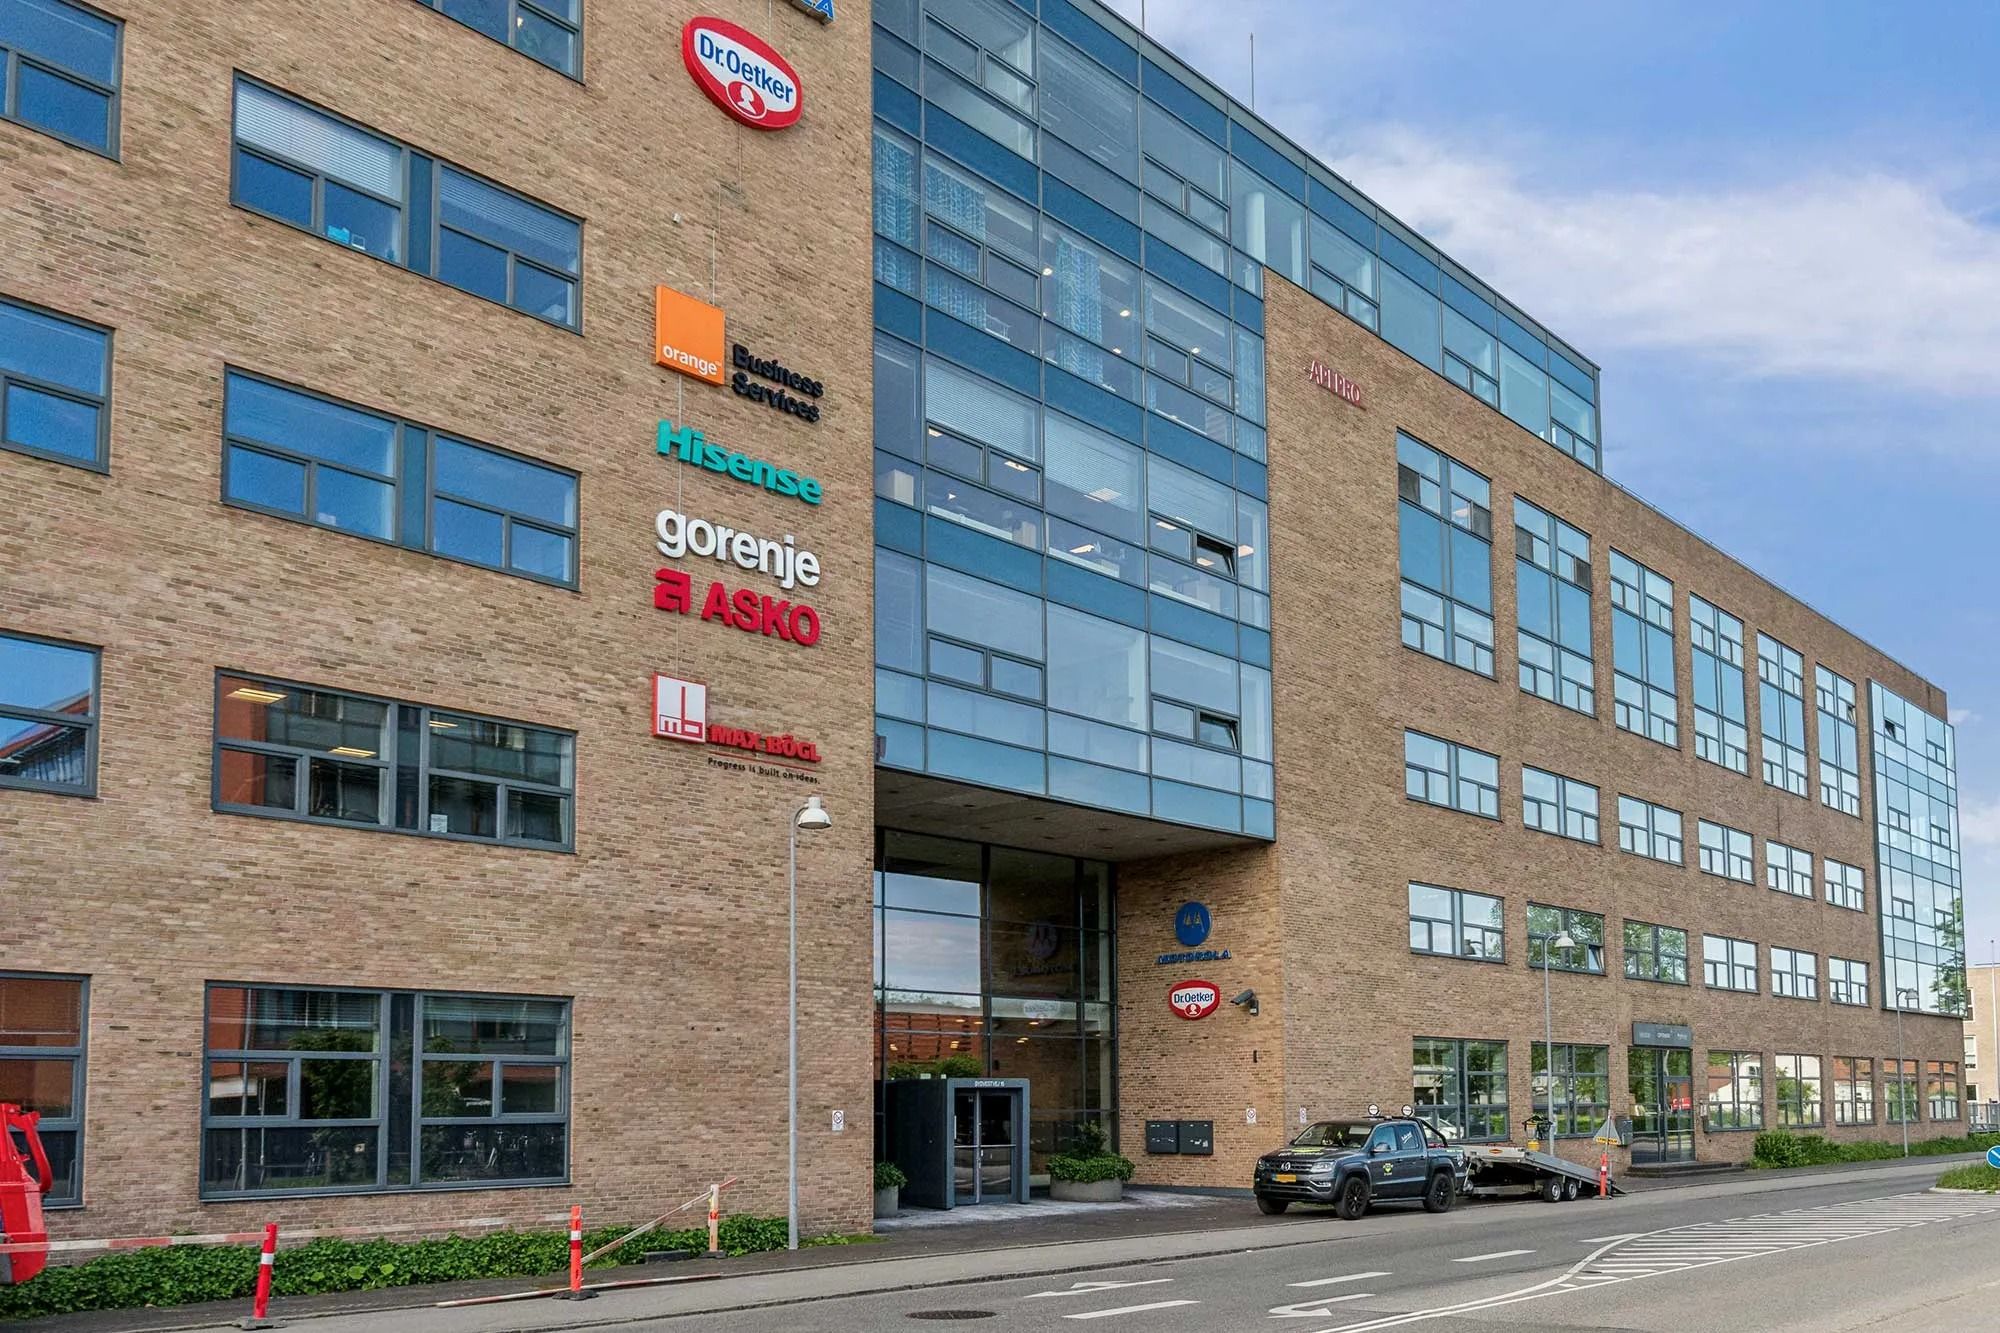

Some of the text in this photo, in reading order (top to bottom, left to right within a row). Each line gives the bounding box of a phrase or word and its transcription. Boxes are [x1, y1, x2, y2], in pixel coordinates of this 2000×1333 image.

[663, 345, 718, 376] orange
[732, 343, 824, 398] Business
[731, 371, 820, 423] Services
[656, 418, 823, 505] Hisense
[655, 509, 821, 589] gorenje
[701, 581, 821, 646] ASKO
[708, 724, 762, 750] MAX
[707, 756, 746, 771] Progress
[748, 763, 757, 774] is
[758, 765, 781, 779] built
[782, 771, 795, 779] on
